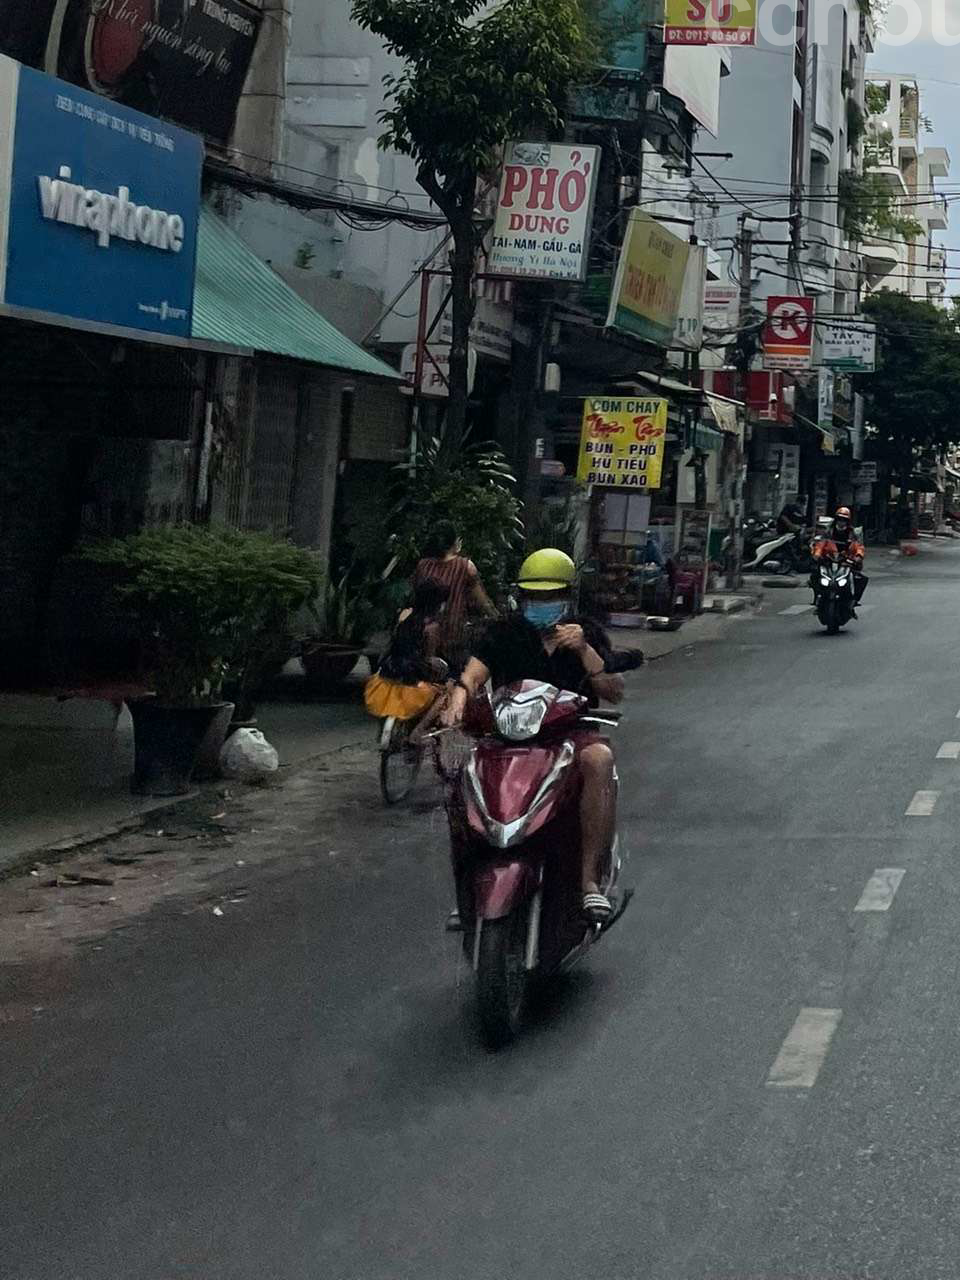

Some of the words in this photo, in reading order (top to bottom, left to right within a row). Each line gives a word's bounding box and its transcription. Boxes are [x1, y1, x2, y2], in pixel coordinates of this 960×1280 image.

[500, 150, 591, 213] PHỞ
[38, 165, 185, 253] vinaphone
[508, 214, 570, 235] DUNG
[626, 401, 660, 413] CHAY
